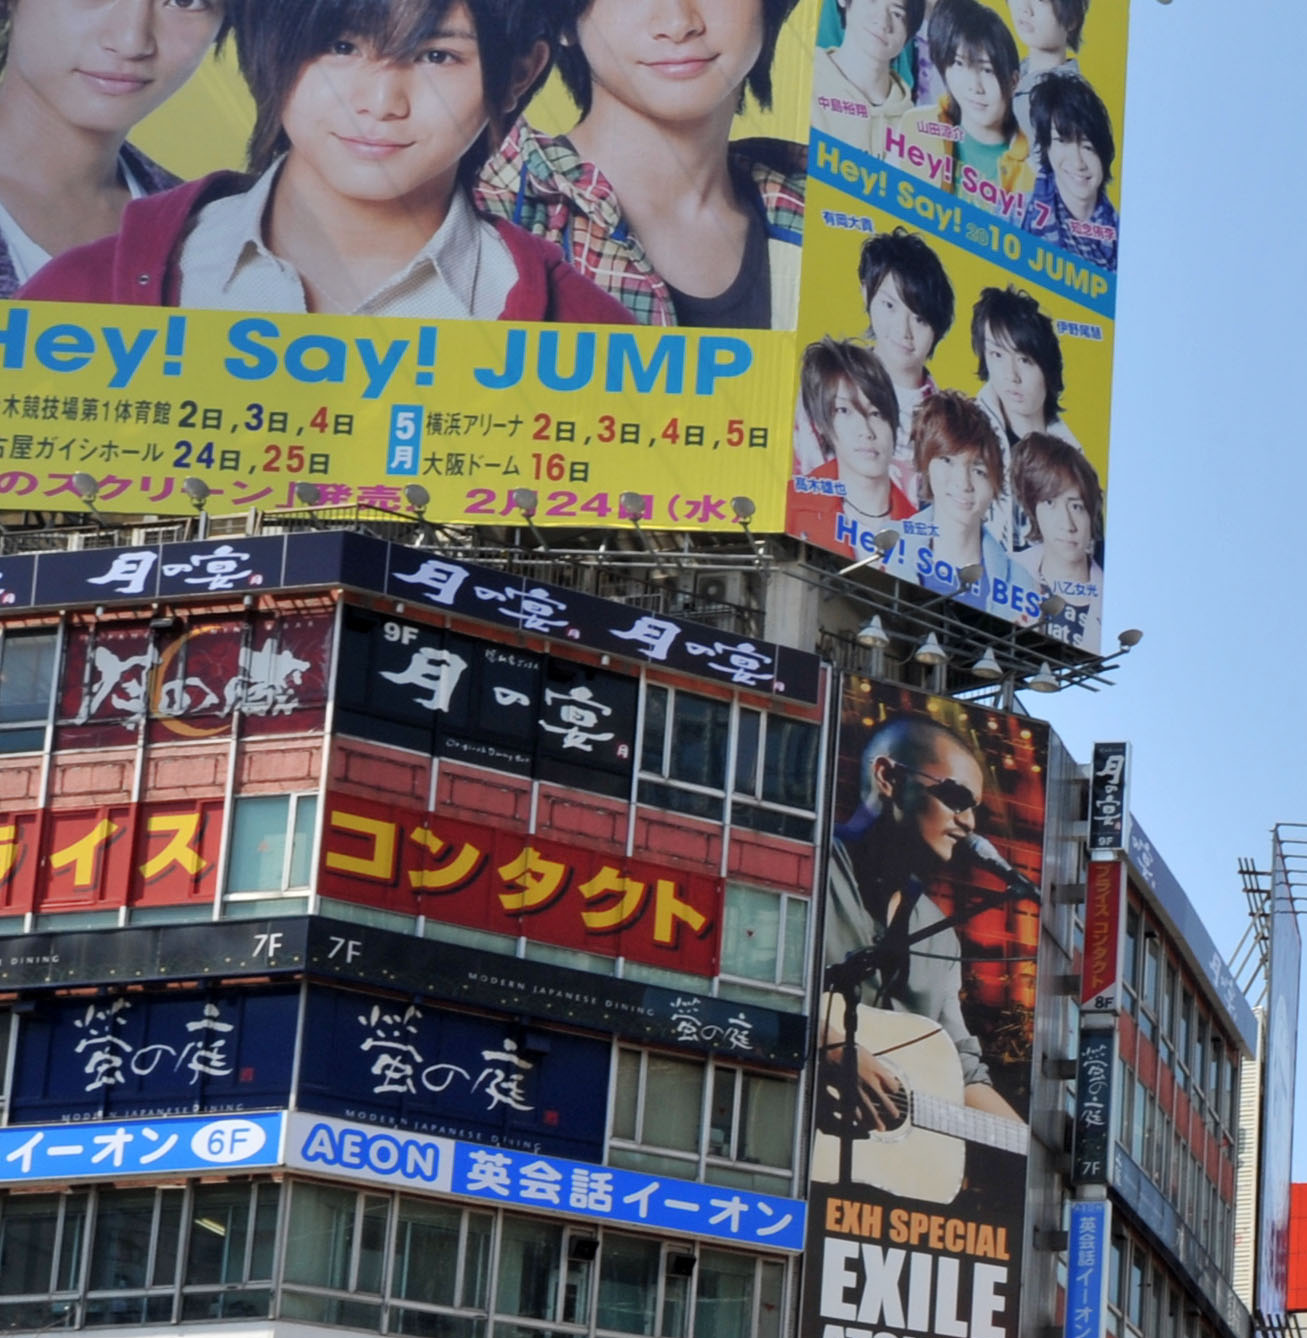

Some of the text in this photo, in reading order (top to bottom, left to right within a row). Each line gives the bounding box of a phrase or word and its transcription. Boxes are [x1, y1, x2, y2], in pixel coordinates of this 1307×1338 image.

[885, 127, 1051, 228] Hey! Say! 7
[817, 141, 888, 197] Hey!
[897, 181, 962, 233] Say!
[1028, 248, 1108, 299] JUMP
[0, 308, 753, 398] Hey! Say! JUMP
[425, 412, 524, 437] 横浜アリーナ
[422, 452, 589, 482] 大阪ドーム 16日
[87, 545, 253, 594] 月の宴
[394, 560, 569, 633] 月の宴
[384, 621, 419, 646] 9F
[611, 616, 773, 685] 月の宴
[381, 648, 615, 753] 月の宴
[325, 810, 707, 944] コンタクト
[252, 932, 284, 959] 7F
[328, 936, 363, 965] 7F
[1094, 996, 1115, 1009] 8F
[6, 1127, 251, 1174] イーオン 6F
[301, 1122, 441, 1183] AEON
[1082, 1161, 1101, 1176] 7F
[466, 1149, 794, 1237] 英会話イーオン
[825, 1198, 1011, 1261] EXH SPECIAL
